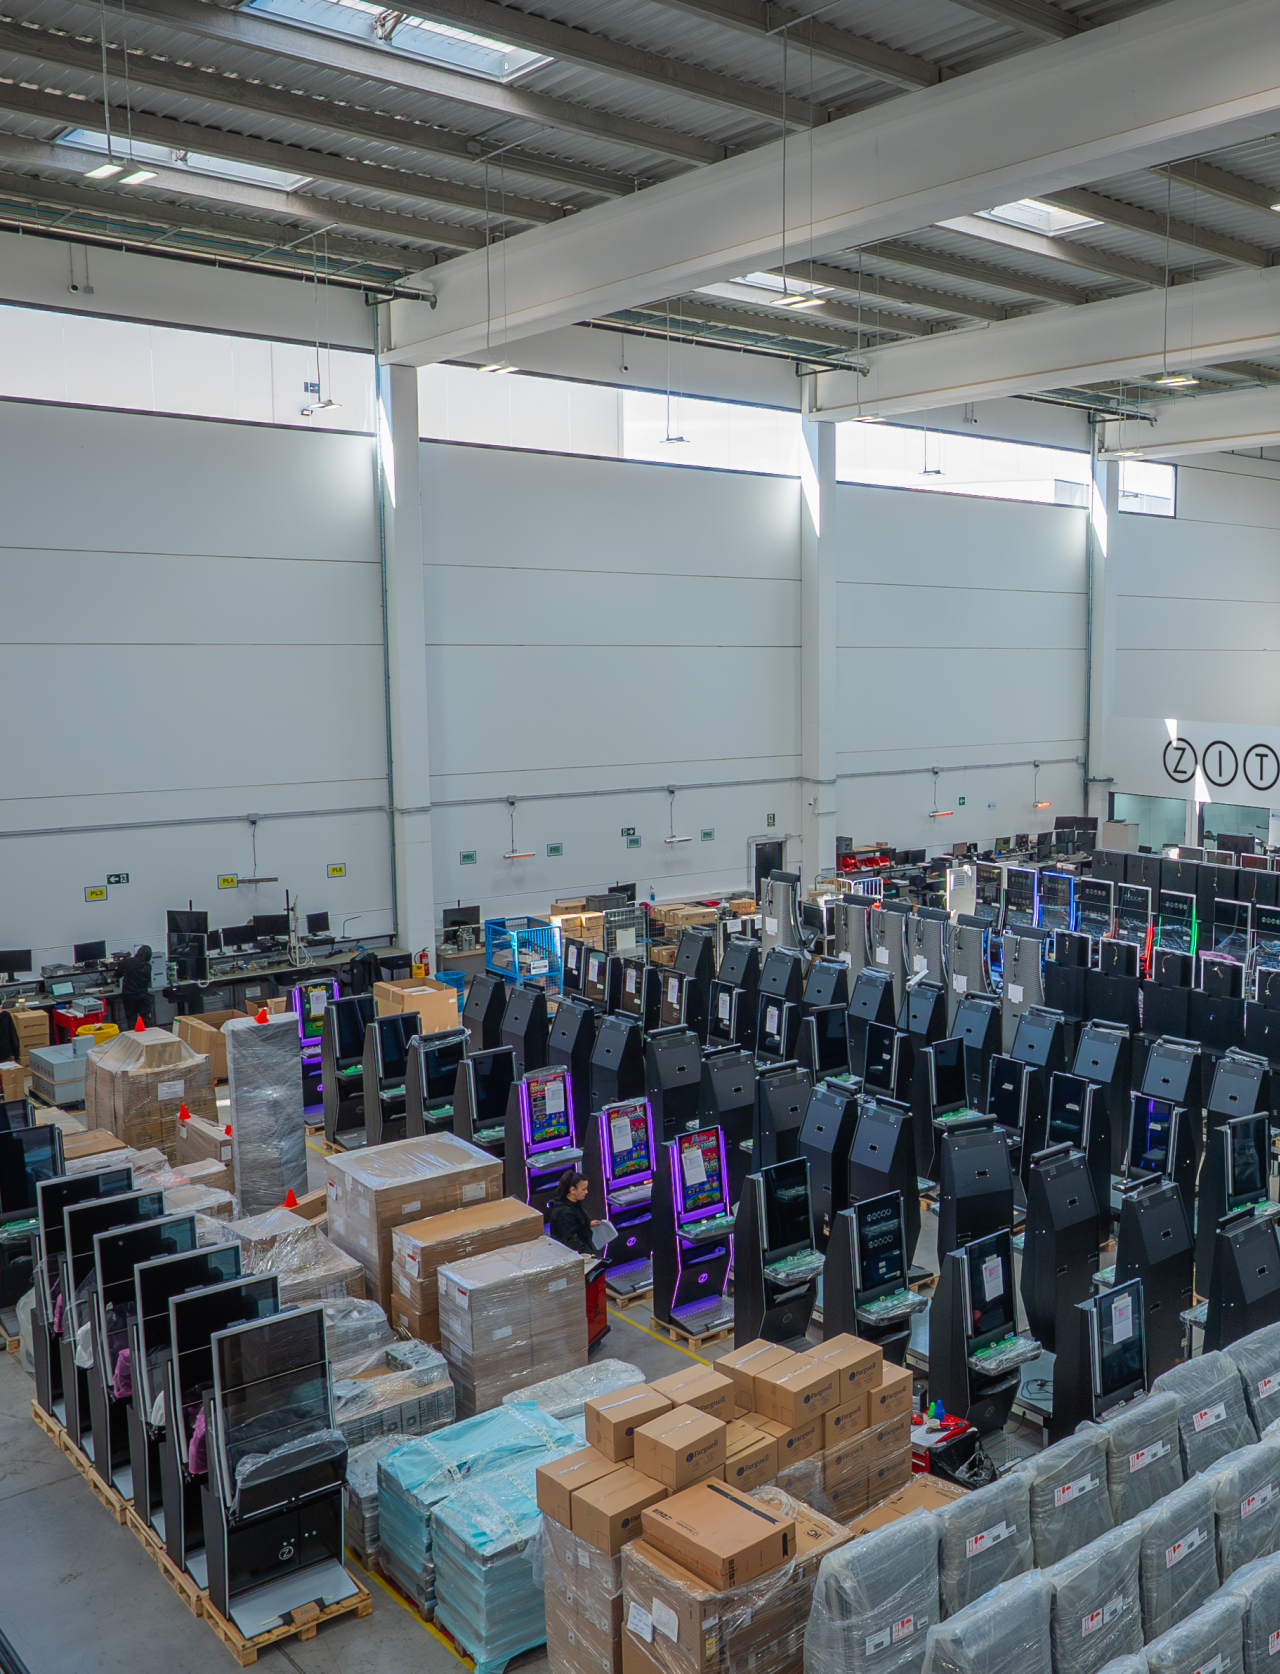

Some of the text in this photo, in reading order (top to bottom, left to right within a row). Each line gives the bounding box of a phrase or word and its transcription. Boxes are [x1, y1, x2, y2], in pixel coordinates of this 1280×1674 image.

[700, 1395, 726, 1412] Farguell
[694, 1438, 719, 1458] Farguell
[744, 1454, 770, 1472] Farguell
